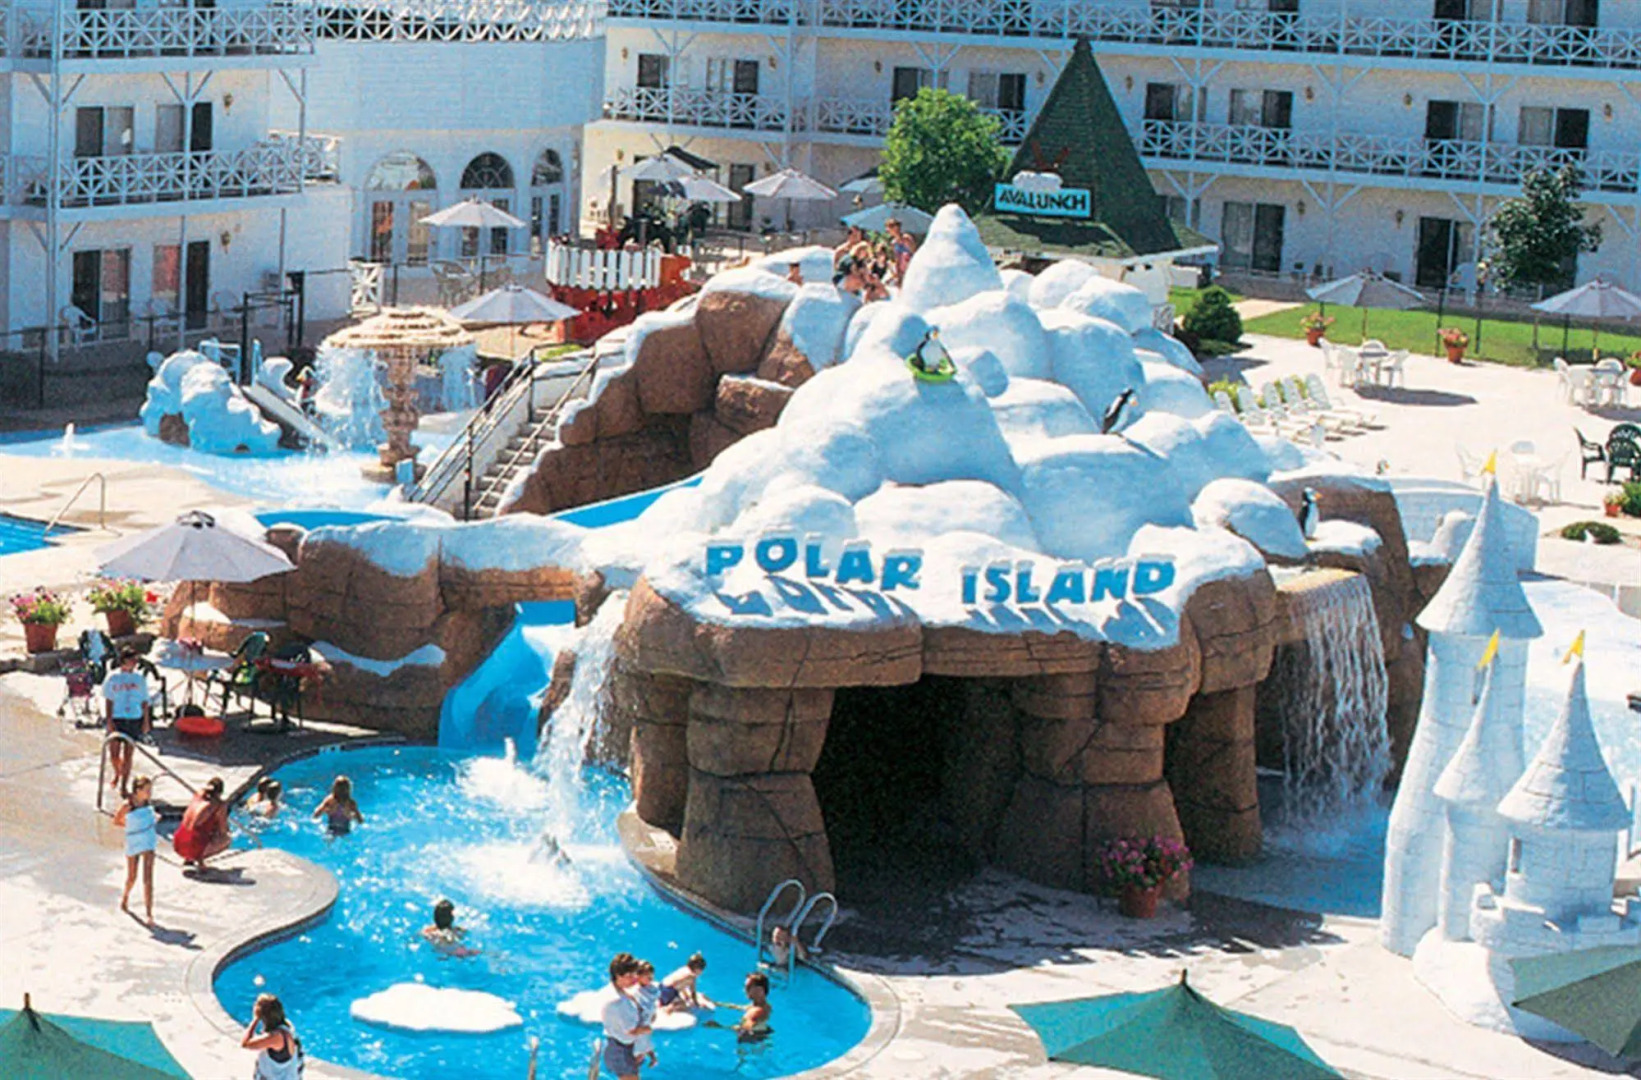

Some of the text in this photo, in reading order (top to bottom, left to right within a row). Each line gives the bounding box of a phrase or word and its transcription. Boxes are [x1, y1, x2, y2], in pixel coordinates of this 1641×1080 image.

[999, 189, 1086, 211] AVALUNCH
[705, 531, 1177, 604] POLAR ISLAND
